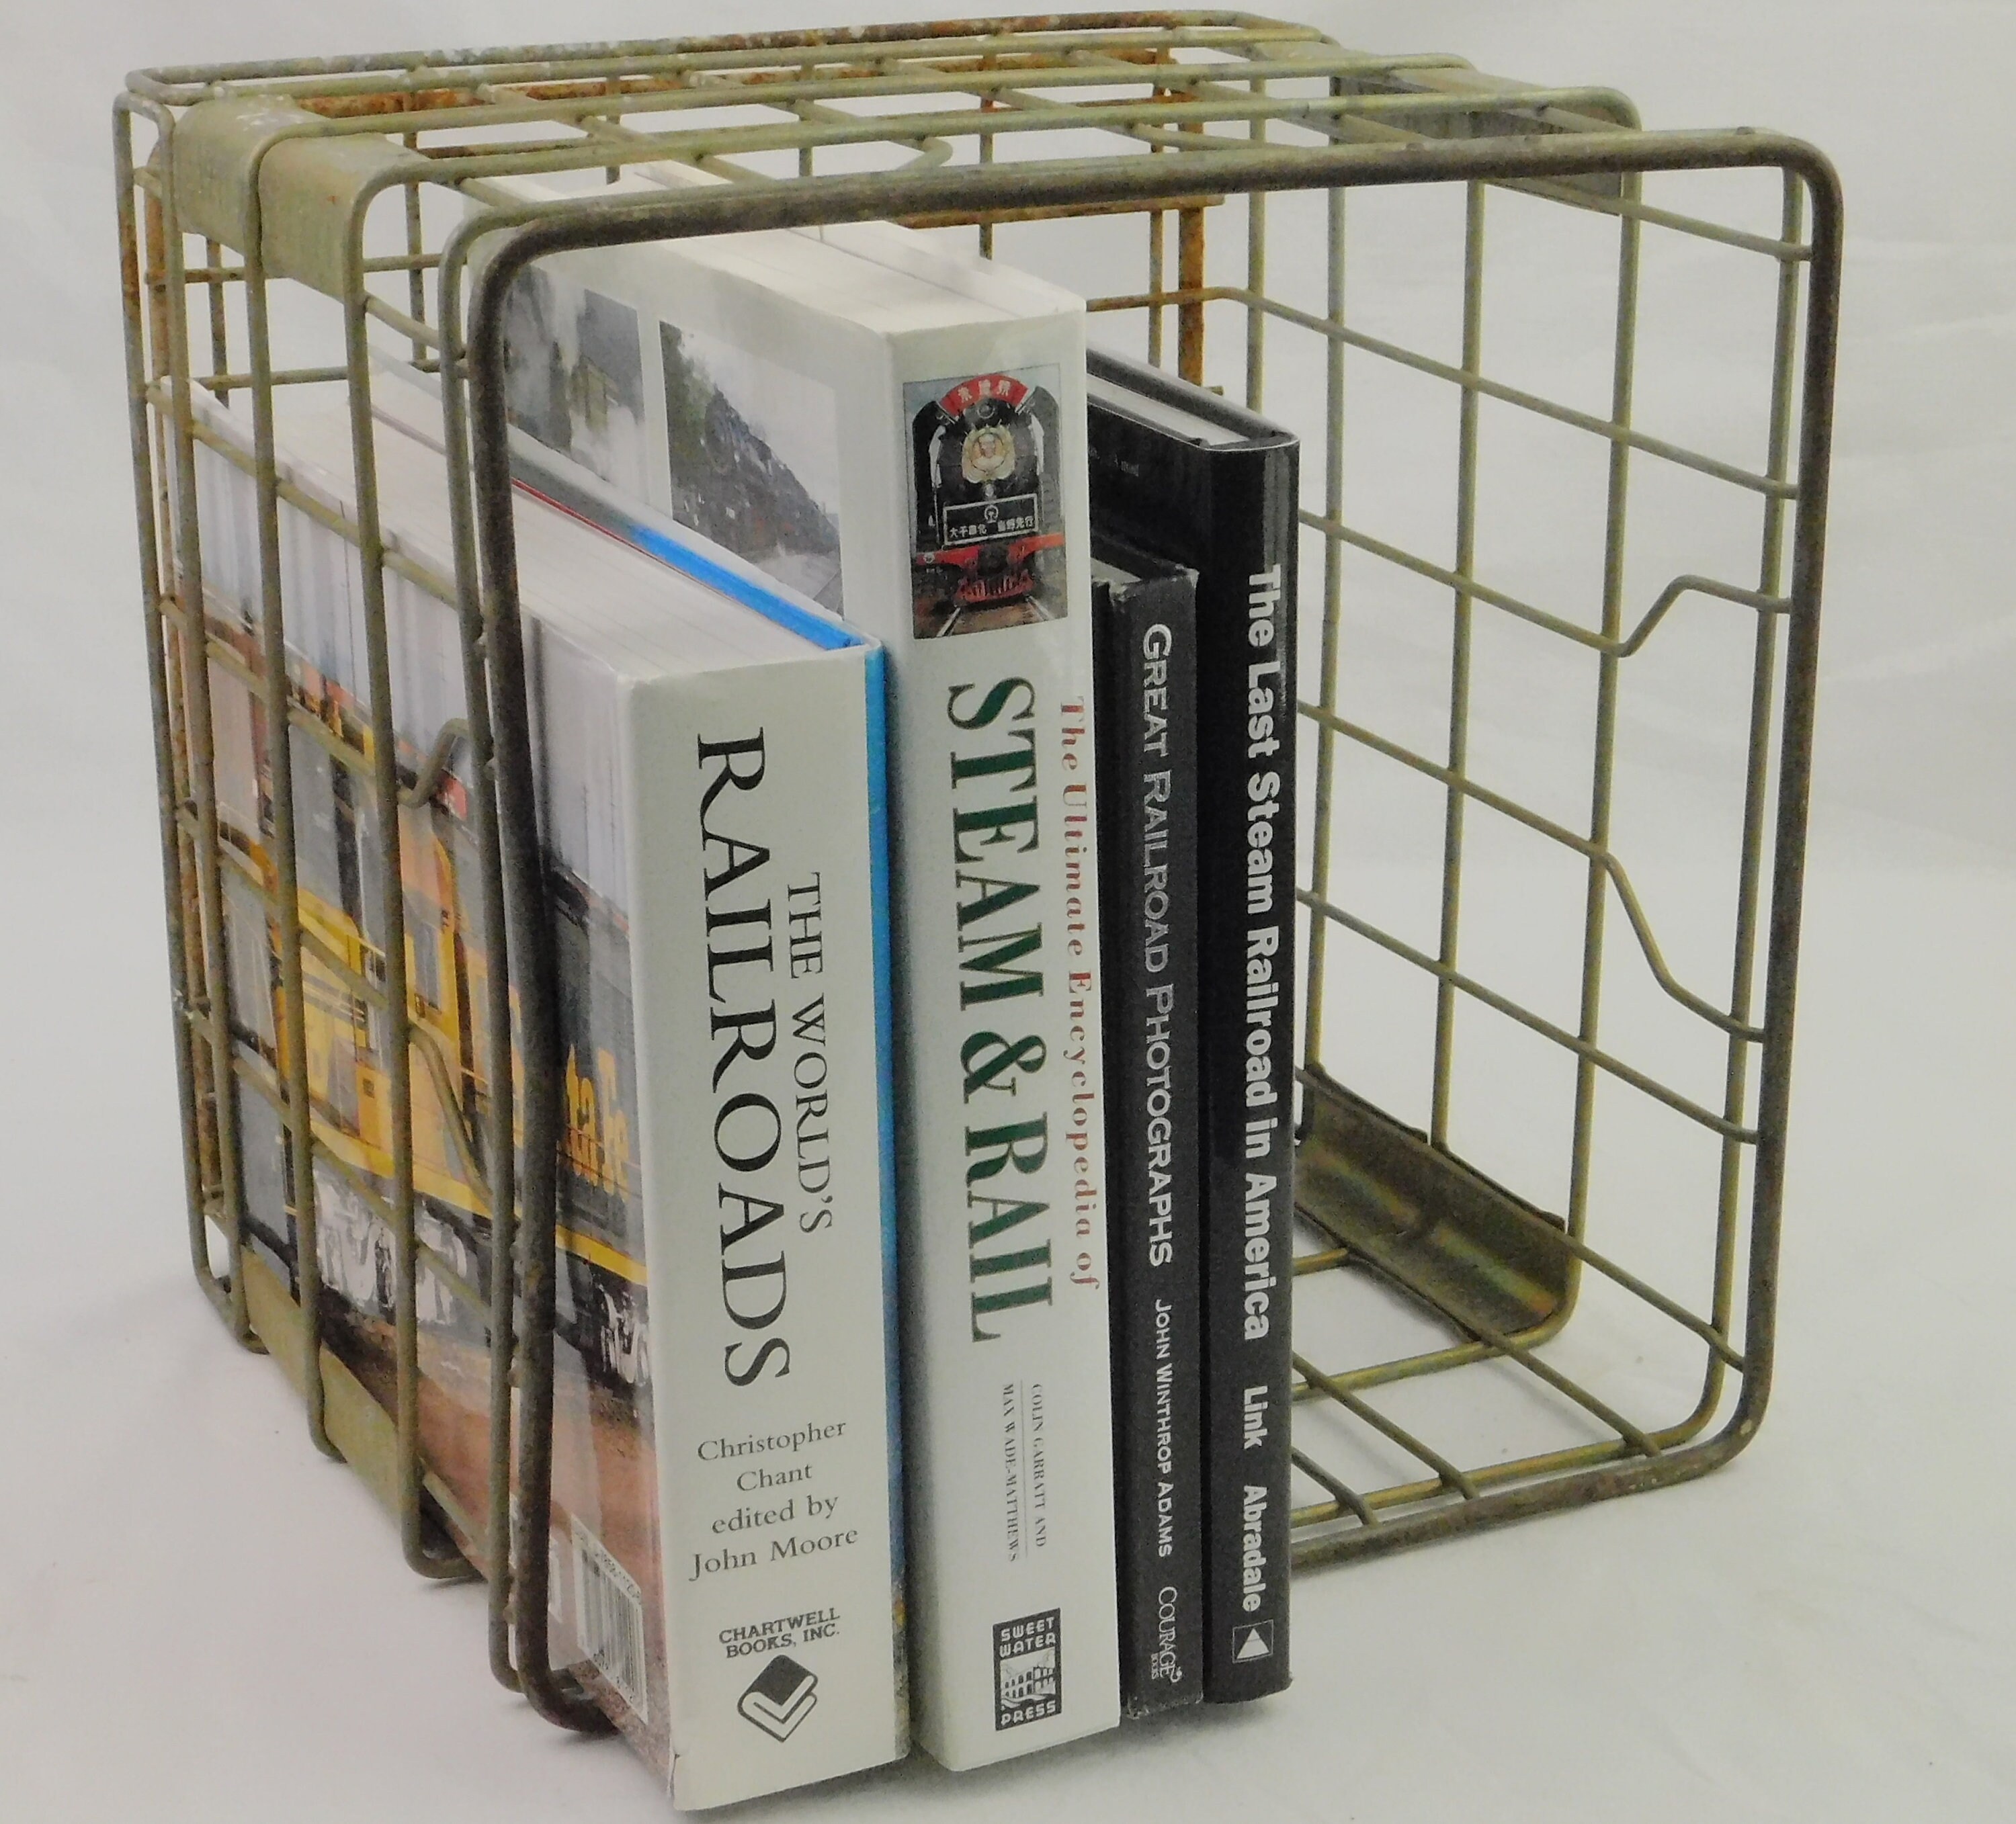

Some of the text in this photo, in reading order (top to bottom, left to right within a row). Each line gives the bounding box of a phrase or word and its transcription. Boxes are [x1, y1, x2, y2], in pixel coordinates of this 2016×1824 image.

[1143, 623, 1173, 1267] GREAT RAILROAD PHOTOGRAPHS
[1245, 564, 1281, 1340] The Last Steam Railroad in America
[947, 677, 1052, 1342] STEAM & RAIL
[1060, 696, 1099, 1290] The Ultimate Encyclopedia of
[698, 727, 790, 1386] RAILROADS
[788, 872, 833, 1233] THE WORLD'S
[698, 1422, 846, 1461] Christopher
[1155, 1299, 1174, 1558] JOHN WINTHROP ADAMS
[1244, 1385, 1269, 1449] Link
[737, 1464, 812, 1491] Chant
[1032, 1383, 1046, 1547] COLIN GARRATT AND
[711, 1495, 838, 1534] edited by
[1243, 1484, 1267, 1612] Abradale
[688, 1529, 858, 1581] John Moore
[719, 1607, 840, 1644] CHARTWELL
[726, 1623, 840, 1658] BOOKS, INC.
[999, 1632, 1056, 1658] WATER
[1001, 1616, 1054, 1642] SWEET
[1159, 1586, 1182, 1683] COURAGE
[1001, 1700, 1056, 1726] PRESS
